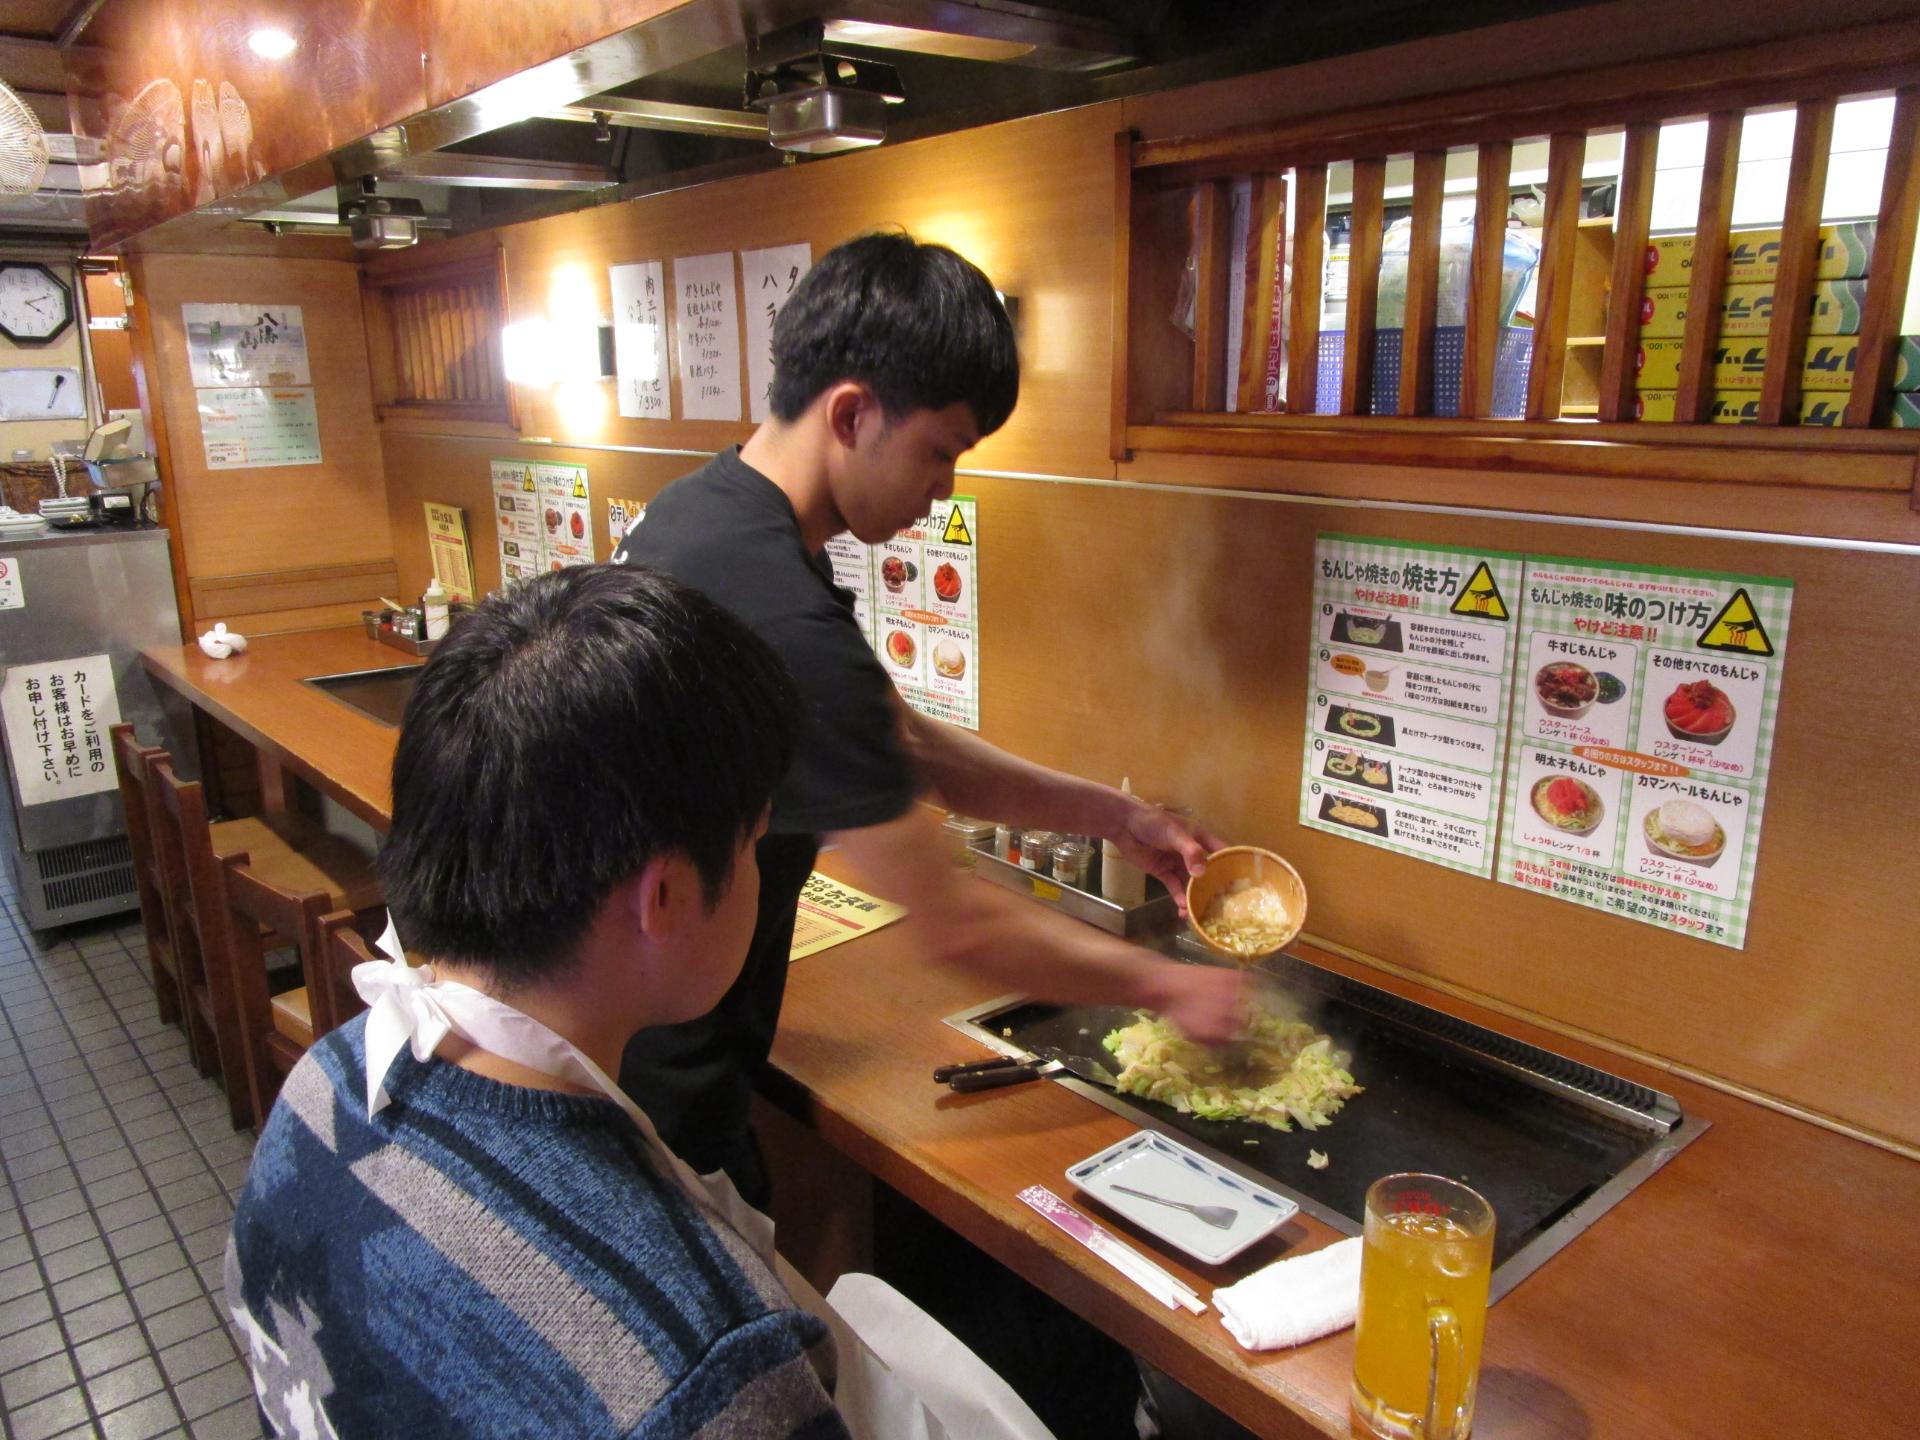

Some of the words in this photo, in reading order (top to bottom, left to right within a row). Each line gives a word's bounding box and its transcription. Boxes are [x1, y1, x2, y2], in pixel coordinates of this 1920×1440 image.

[1547, 639, 1617, 661] 牛すじもんじゃ
[1652, 654, 1759, 682] その他すべてのもんじゃ
[1405, 681, 1441, 694] 味をつけます。
[1406, 671, 1481, 692] 容器に残したもんじゃの汁に
[25, 678, 62, 785] お申し付け下さい。
[50, 673, 82, 779] お客様はお早めに
[73, 671, 105, 773] カードをご利用の
[1539, 718, 1590, 734] ウスターソース
[1654, 740, 1713, 757] ウスターソース
[1534, 752, 1606, 779] 明太子もんじゃ
[1637, 774, 1743, 807] カマンベールもんじゃ
[1640, 856, 1698, 877] ウスターソース
